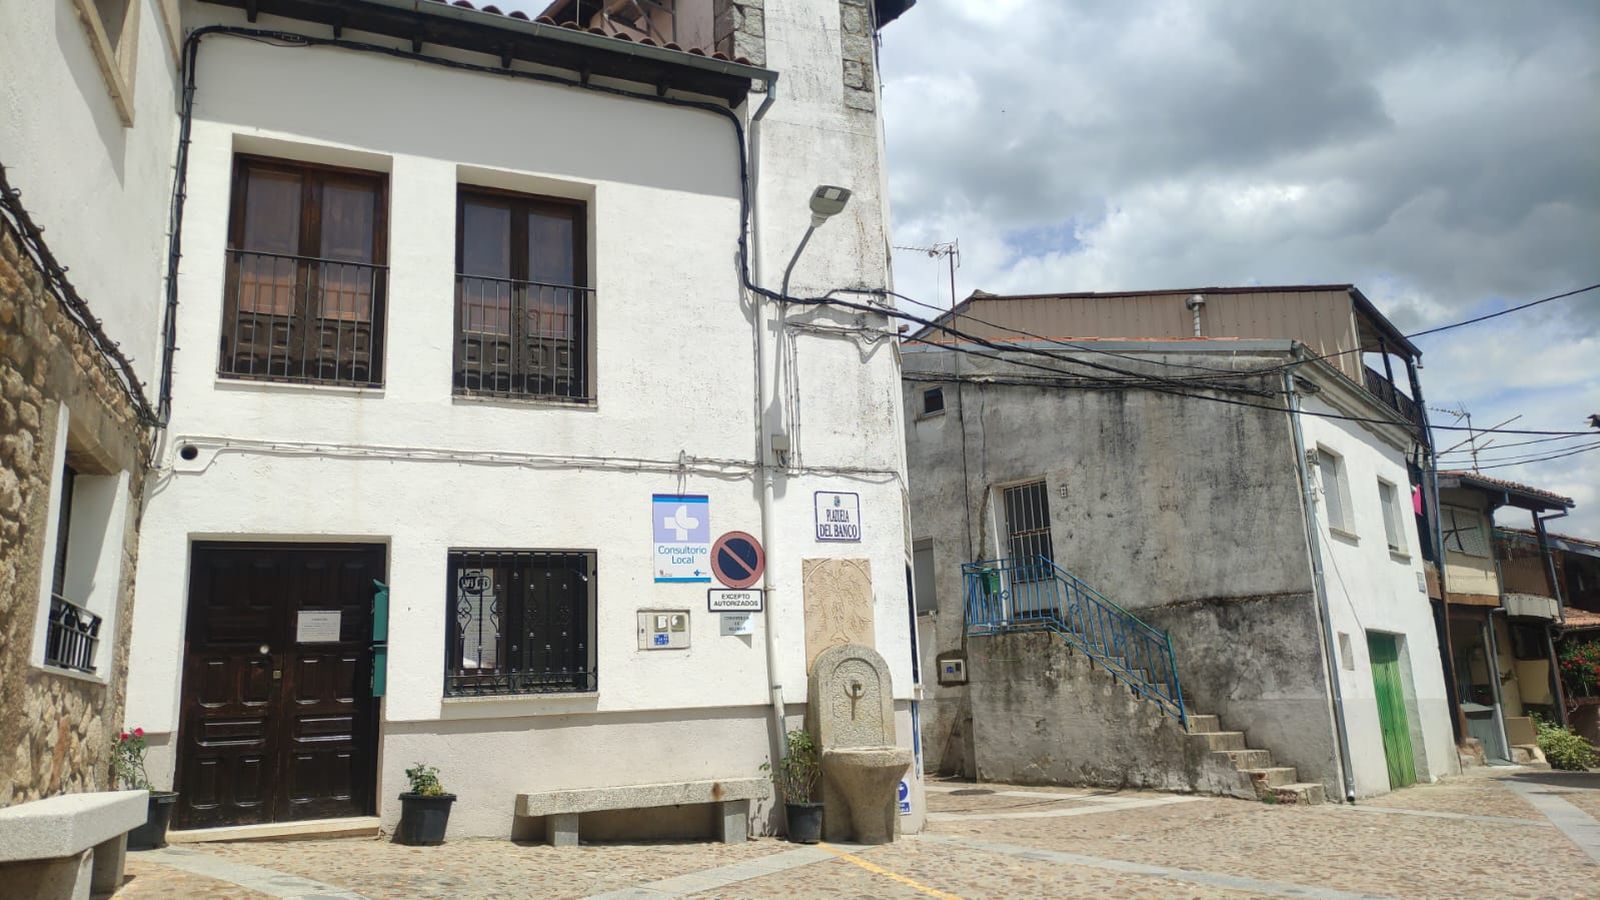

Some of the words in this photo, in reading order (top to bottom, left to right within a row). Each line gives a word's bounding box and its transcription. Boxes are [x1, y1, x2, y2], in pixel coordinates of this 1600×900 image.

[820, 524, 833, 537] DEL
[834, 524, 857, 538] BANCO
[658, 545, 707, 555] Consultorio
[671, 555, 695, 564] Local
